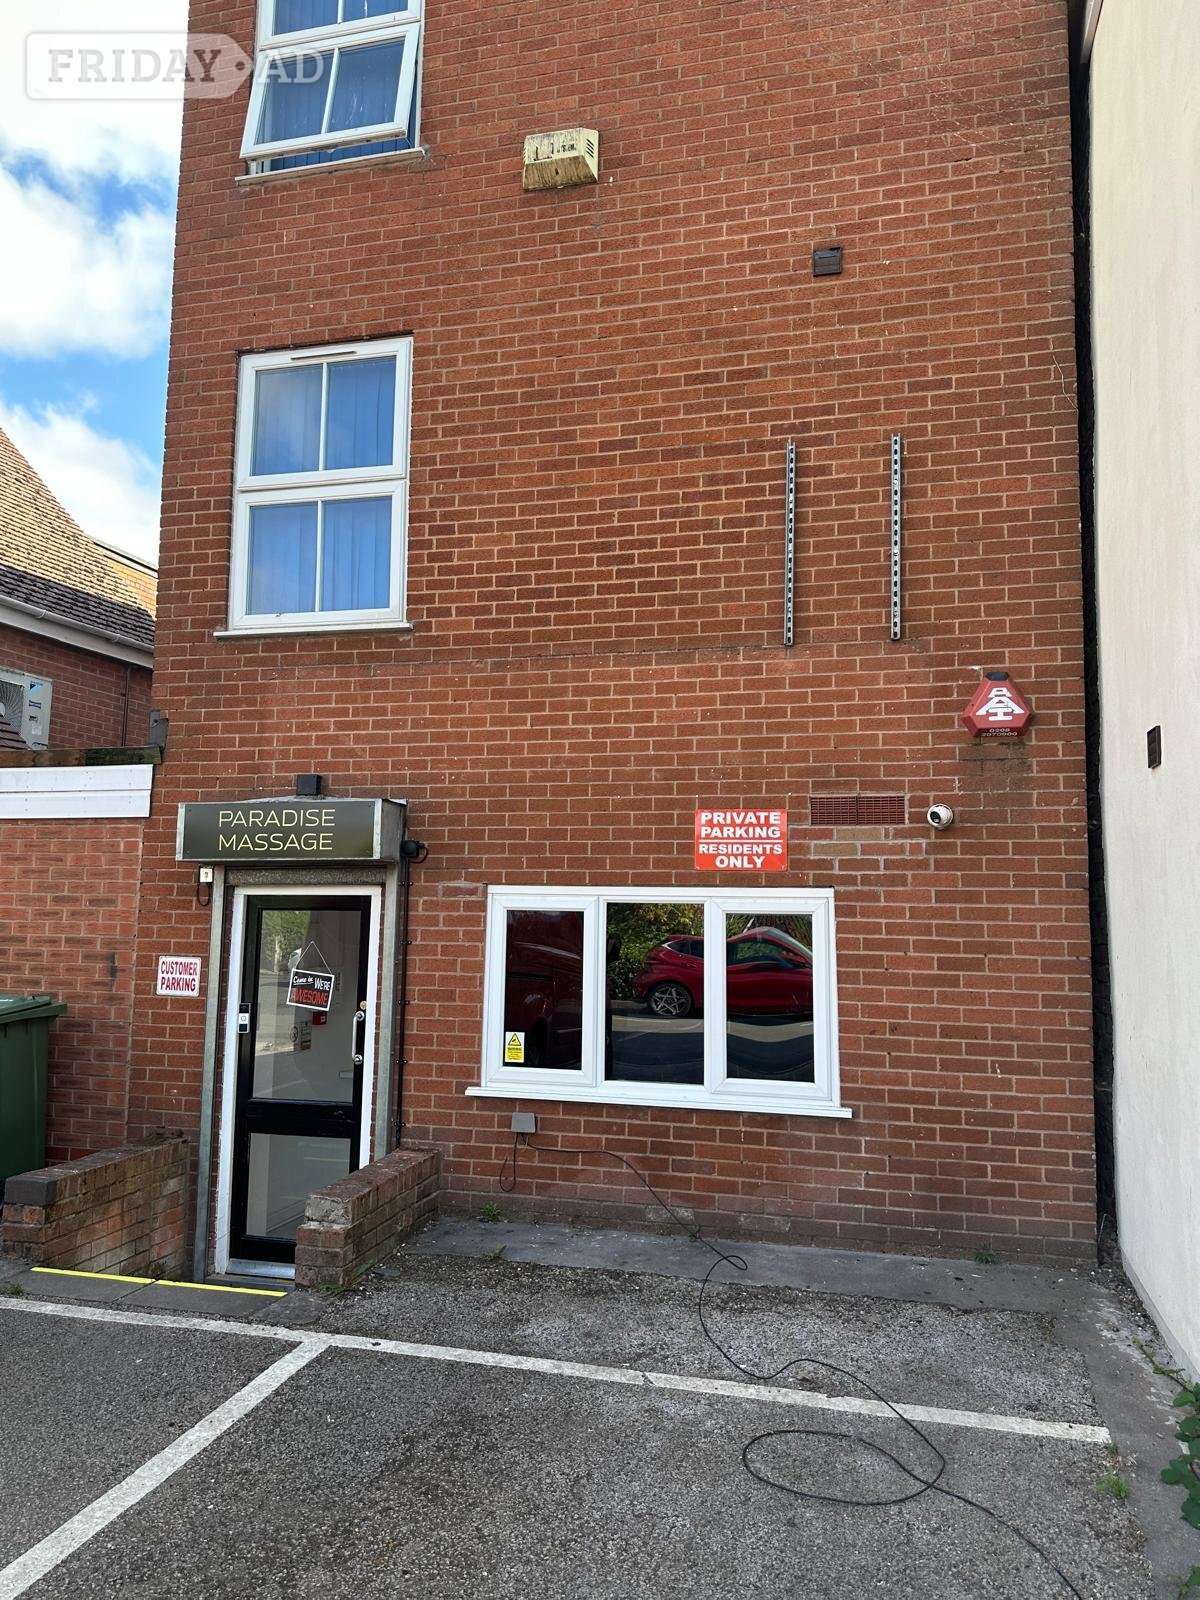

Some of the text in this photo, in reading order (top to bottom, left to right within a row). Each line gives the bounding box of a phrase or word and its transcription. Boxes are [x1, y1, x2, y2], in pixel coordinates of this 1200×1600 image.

[218, 808, 336, 828] PARADISE
[700, 811, 782, 825] PRIVATE
[700, 826, 782, 839] PARKING
[218, 832, 334, 851] MASSAGE
[698, 843, 783, 855] RESIDENTS
[715, 855, 766, 869] ONLY
[160, 960, 198, 976] CUSTOMER
[160, 976, 197, 992] PARKING
[290, 987, 328, 1005] AWESOME
